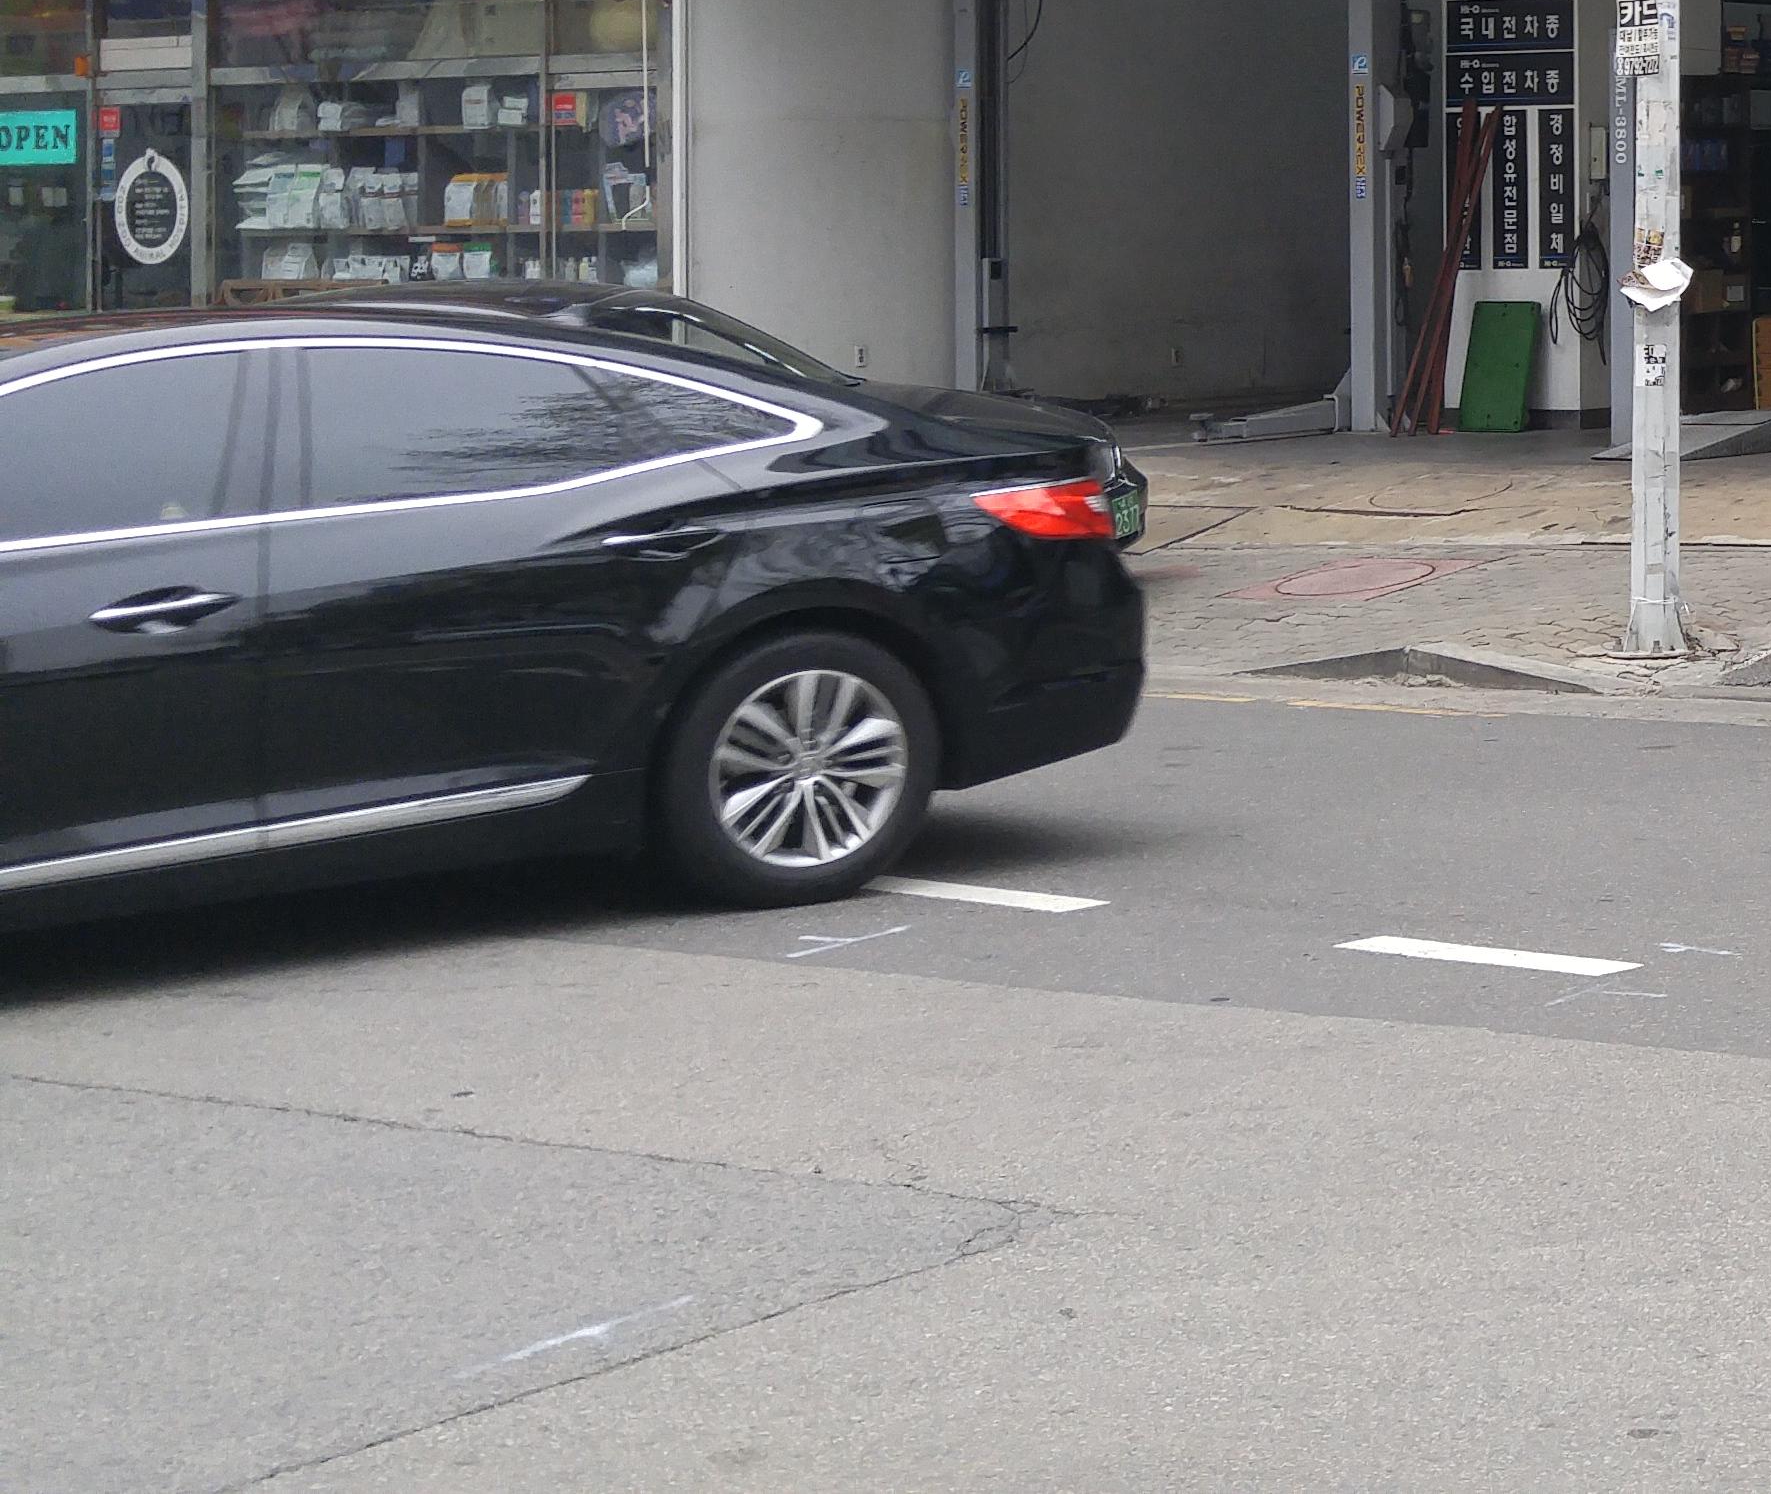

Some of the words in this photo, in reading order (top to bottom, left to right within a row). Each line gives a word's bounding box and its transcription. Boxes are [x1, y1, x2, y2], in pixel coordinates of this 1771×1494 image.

[1620, 0, 1658, 26] 카드
[1460, 14, 1560, 40] 국내전차종
[1460, 69, 1560, 95] 수입전차종
